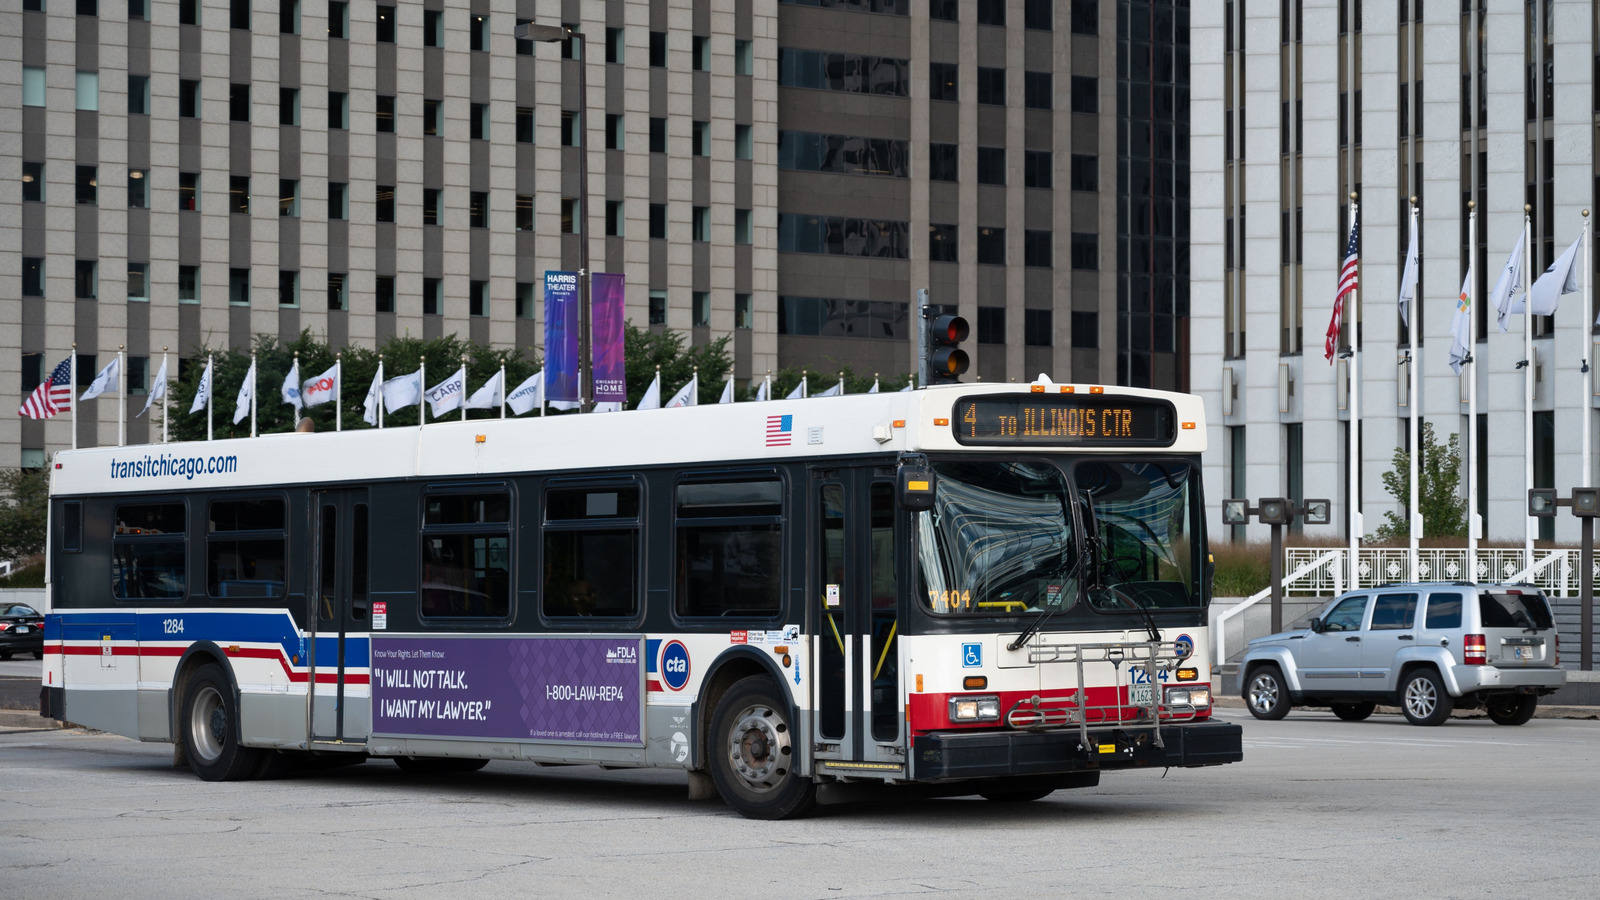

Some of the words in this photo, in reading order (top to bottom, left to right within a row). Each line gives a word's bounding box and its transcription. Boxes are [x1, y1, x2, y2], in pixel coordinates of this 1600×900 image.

[547, 274, 576, 283] HARRIS
[547, 283, 576, 291] THEATER
[596, 384, 623, 395] HOME
[964, 403, 977, 437] 4
[999, 416, 1018, 436] TO
[1024, 408, 1096, 436] ILLINOIS
[1102, 409, 1132, 437] CTR
[111, 453, 237, 481] transitchicago.com
[928, 589, 971, 609] 7404
[163, 618, 184, 634] 1284
[374, 650, 387, 658] Know
[387, 650, 397, 658] Your
[411, 650, 419, 658] Let
[419, 650, 431, 658] Them
[617, 646, 636, 658] FDLA
[666, 656, 686, 673] cta
[386, 669, 411, 688] WILL
[413, 669, 436, 689] NOT
[437, 669, 468, 690] TALK.
[1128, 664, 1169, 684] 124
[545, 685, 624, 701] 1-800-LAW-REP4
[1137, 689, 1161, 702] 16236
[380, 698, 384, 718] I
[386, 698, 417, 719] WANT
[418, 699, 435, 719] MY
[437, 699, 492, 721] LAWYER."
[536, 729, 547, 737] loved
[613, 732, 623, 740] FREE
